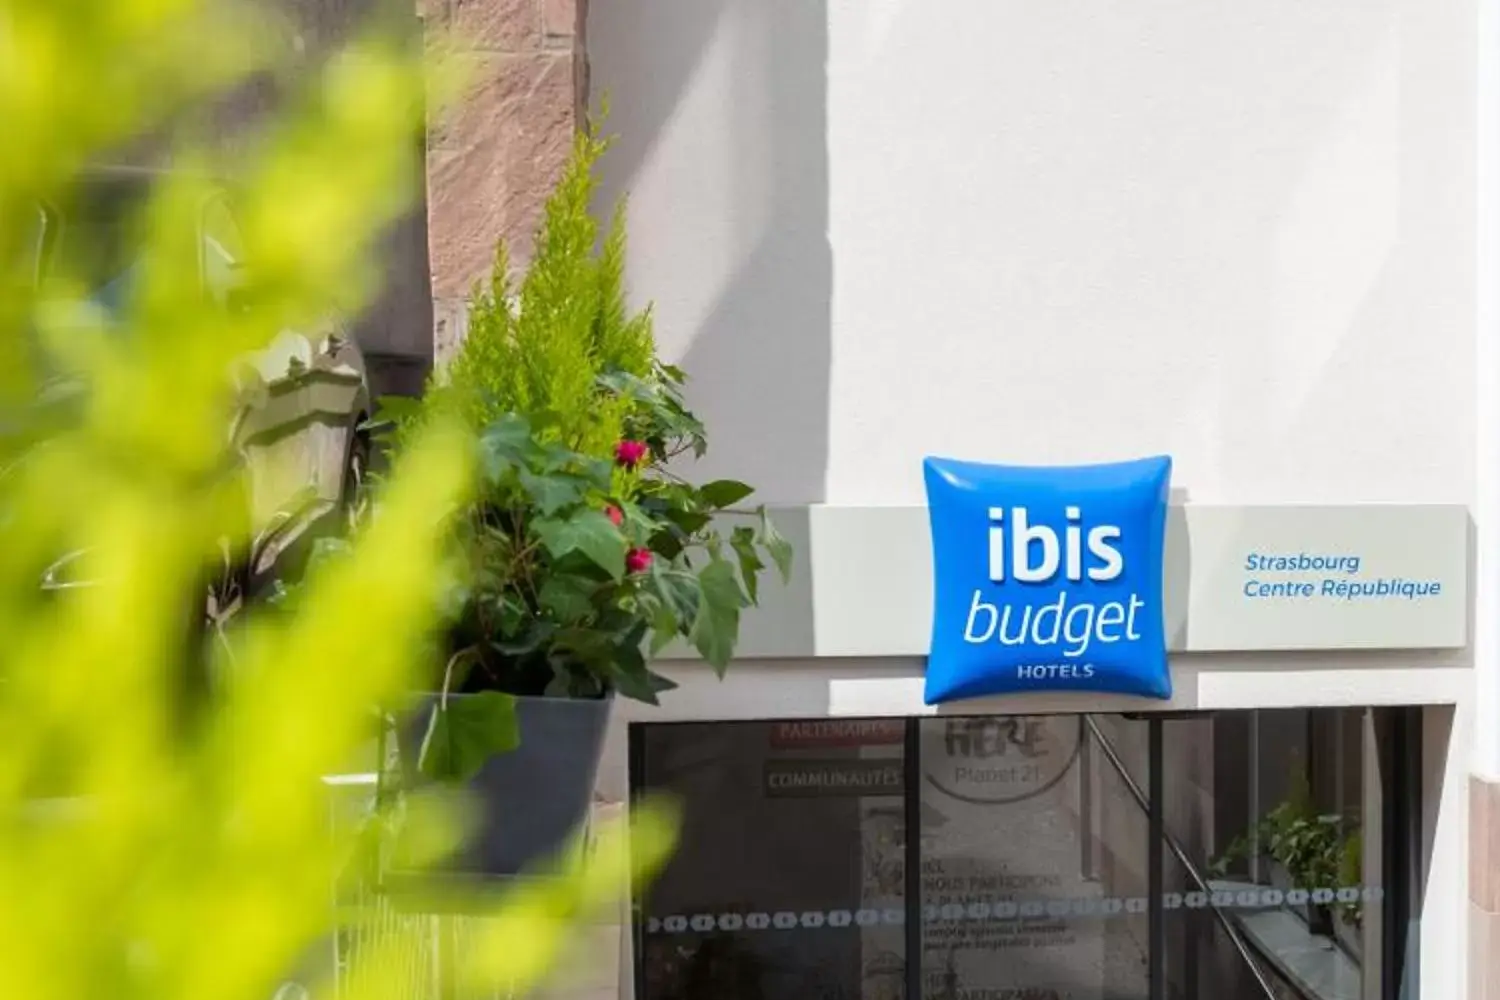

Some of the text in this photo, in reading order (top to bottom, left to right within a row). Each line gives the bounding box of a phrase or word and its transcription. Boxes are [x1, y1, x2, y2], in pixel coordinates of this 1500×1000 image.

[987, 506, 1123, 583] ibis
[1244, 553, 1360, 575] Strasbourg
[1244, 577, 1442, 601] Centre République
[963, 590, 1145, 657] budget
[1016, 663, 1095, 680] HOTELS
[768, 766, 900, 789] COMMUNAUTÉS
[955, 767, 1016, 784] Planet
